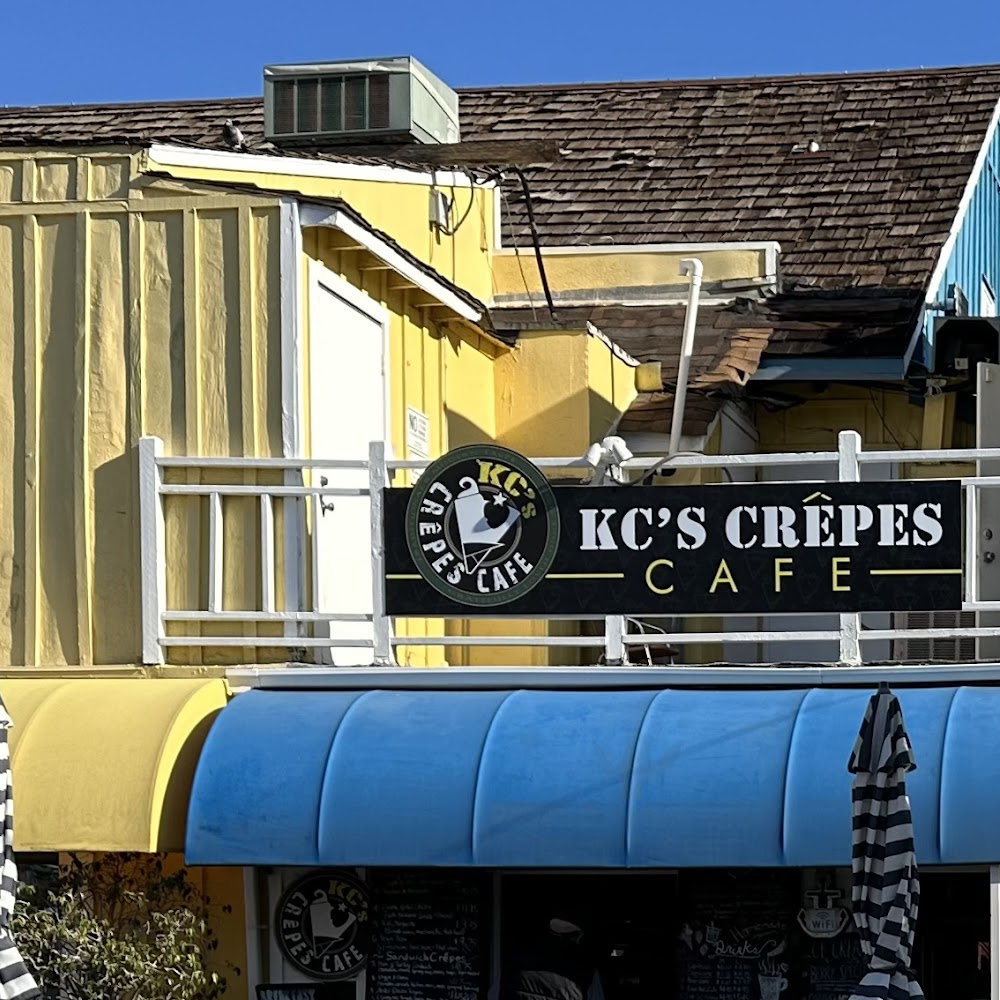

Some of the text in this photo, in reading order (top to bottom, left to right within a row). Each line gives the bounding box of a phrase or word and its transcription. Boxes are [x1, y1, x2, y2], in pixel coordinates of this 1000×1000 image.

[418, 481, 534, 593] CRÊPES CAFE
[579, 491, 943, 550] KC'S CRÊPES
[645, 557, 851, 595] CAFE
[321, 944, 364, 973] CAFE
